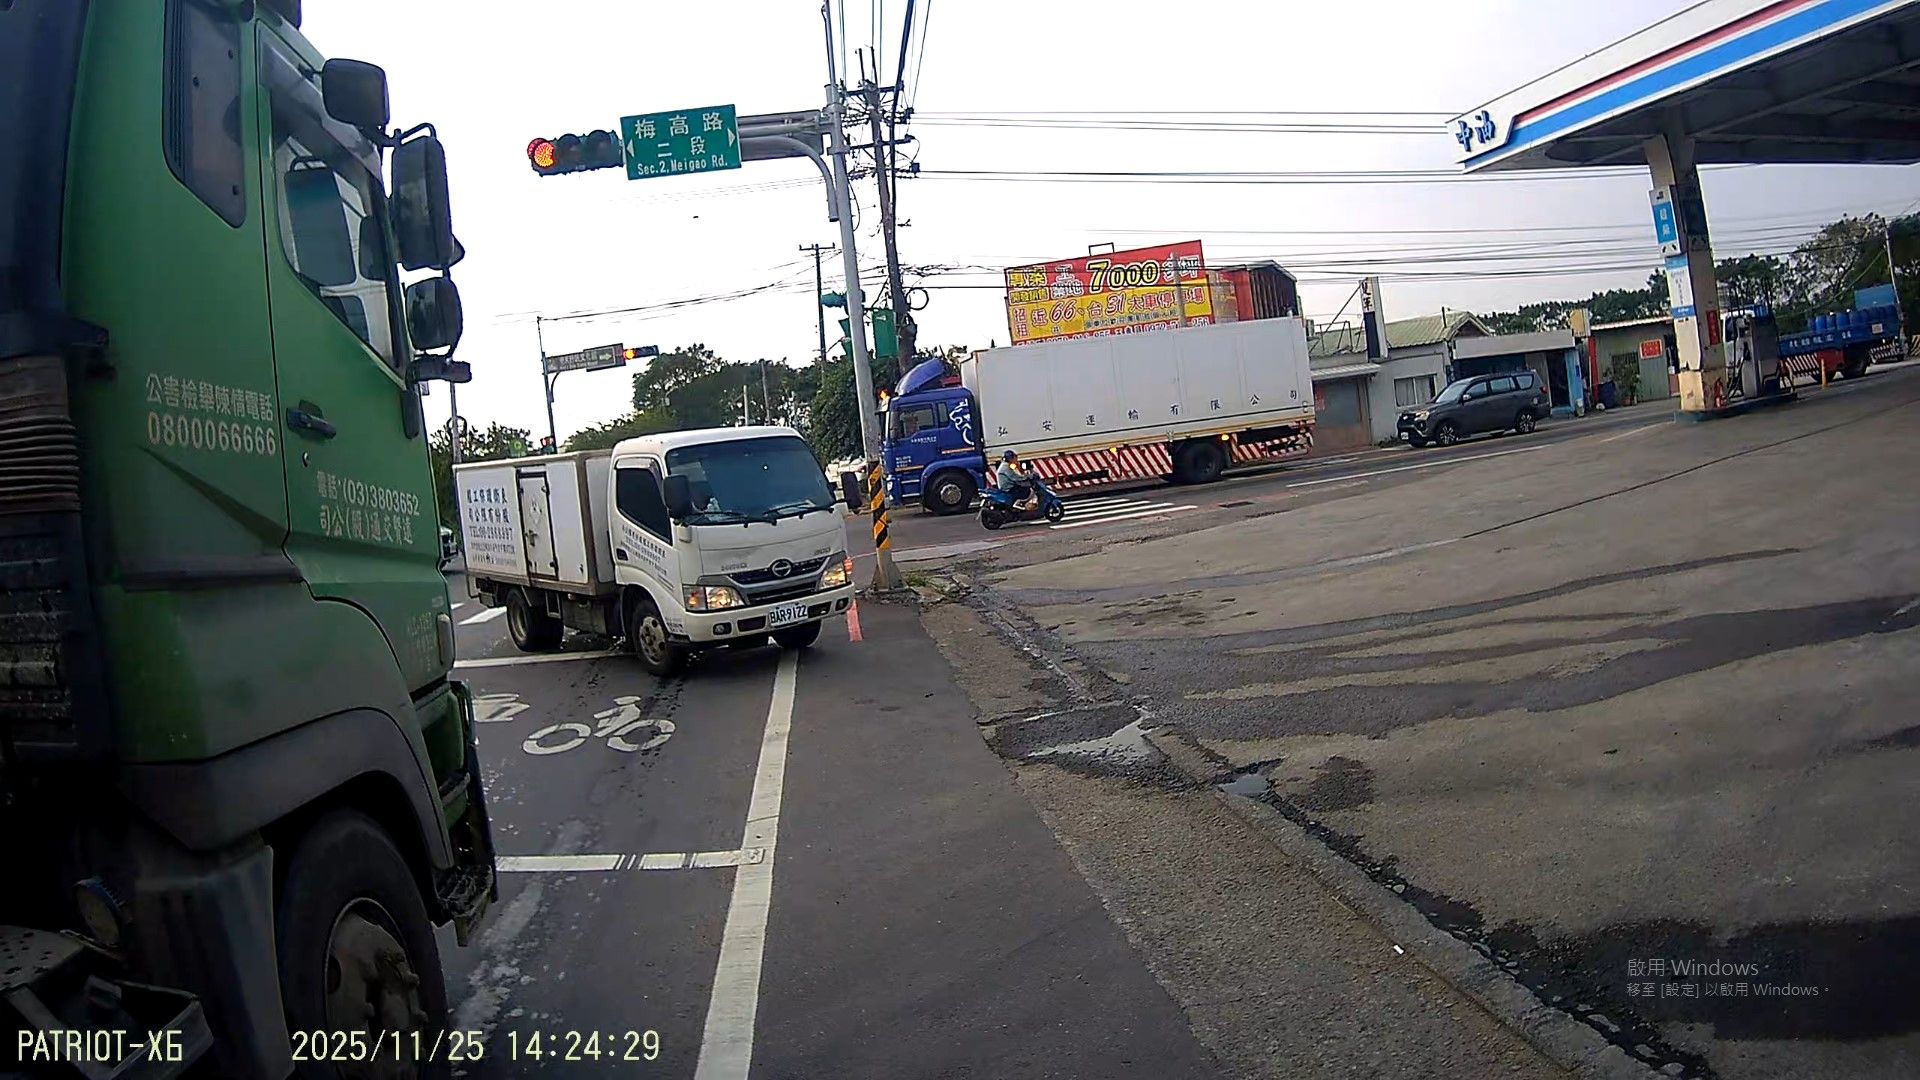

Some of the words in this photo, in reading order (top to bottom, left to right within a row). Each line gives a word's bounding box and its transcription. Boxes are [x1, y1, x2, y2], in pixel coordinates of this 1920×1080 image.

[635, 112, 723, 139] 梅高路
[1455, 110, 1496, 152] 中油
[657, 136, 706, 158] 二段
[711, 154, 728, 168] Rd.
[146, 373, 273, 421] 公害檢舉陳情電話
[998, 389, 1298, 436] 弘安運輸有限公司
[148, 411, 276, 456] 0800066666
